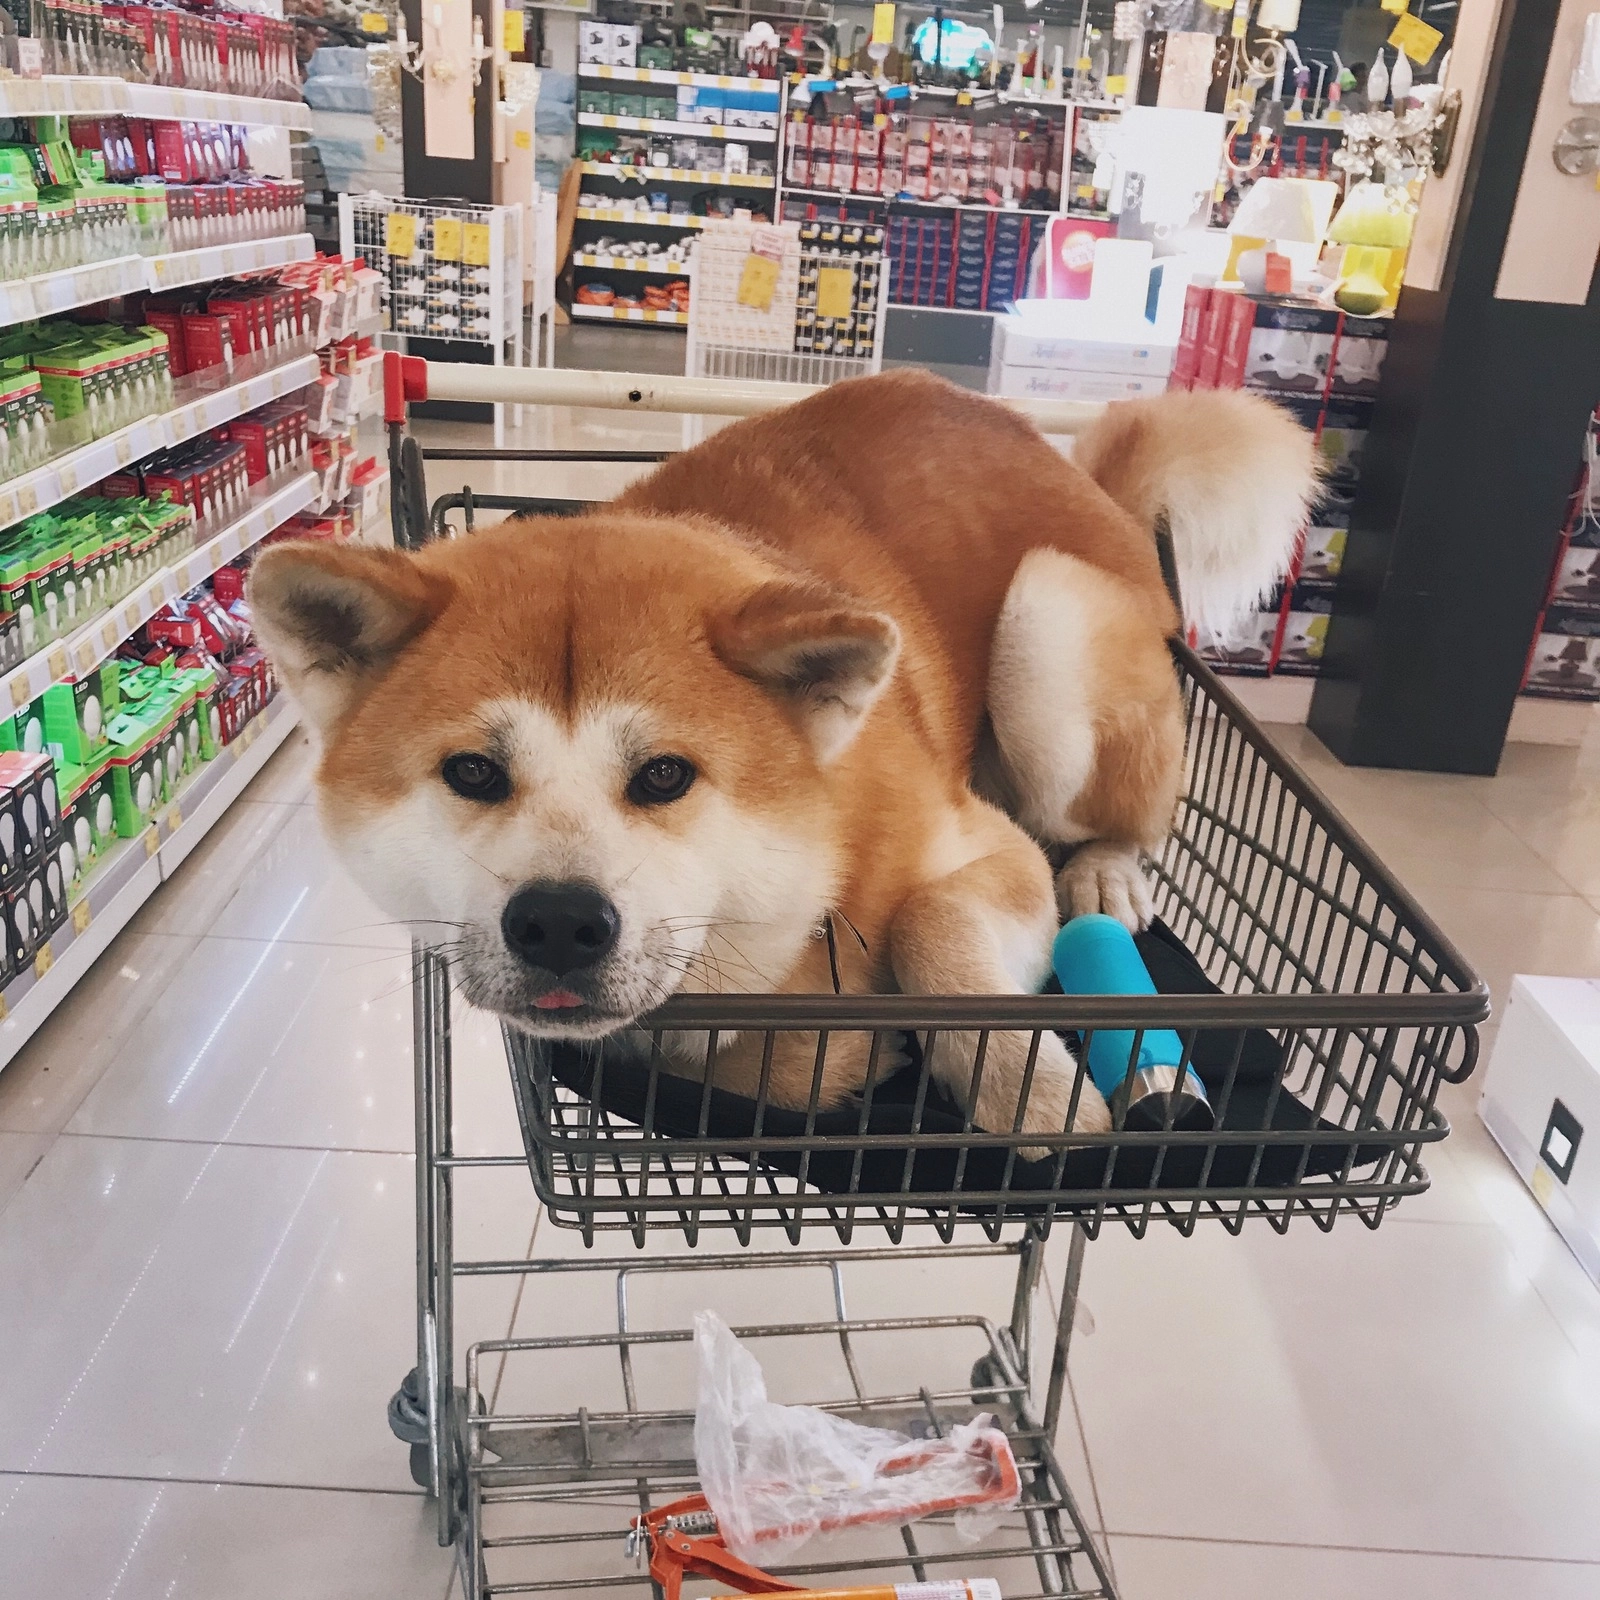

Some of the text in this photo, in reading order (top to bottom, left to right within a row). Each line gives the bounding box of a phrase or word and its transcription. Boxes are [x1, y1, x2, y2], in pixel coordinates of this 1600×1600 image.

[56, 565, 69, 577] LED
[37, 576, 49, 589] LED
[12, 588, 25, 601] LED
[74, 681, 88, 695] LED
[131, 760, 143, 774] LED
[89, 781, 102, 795] LED
